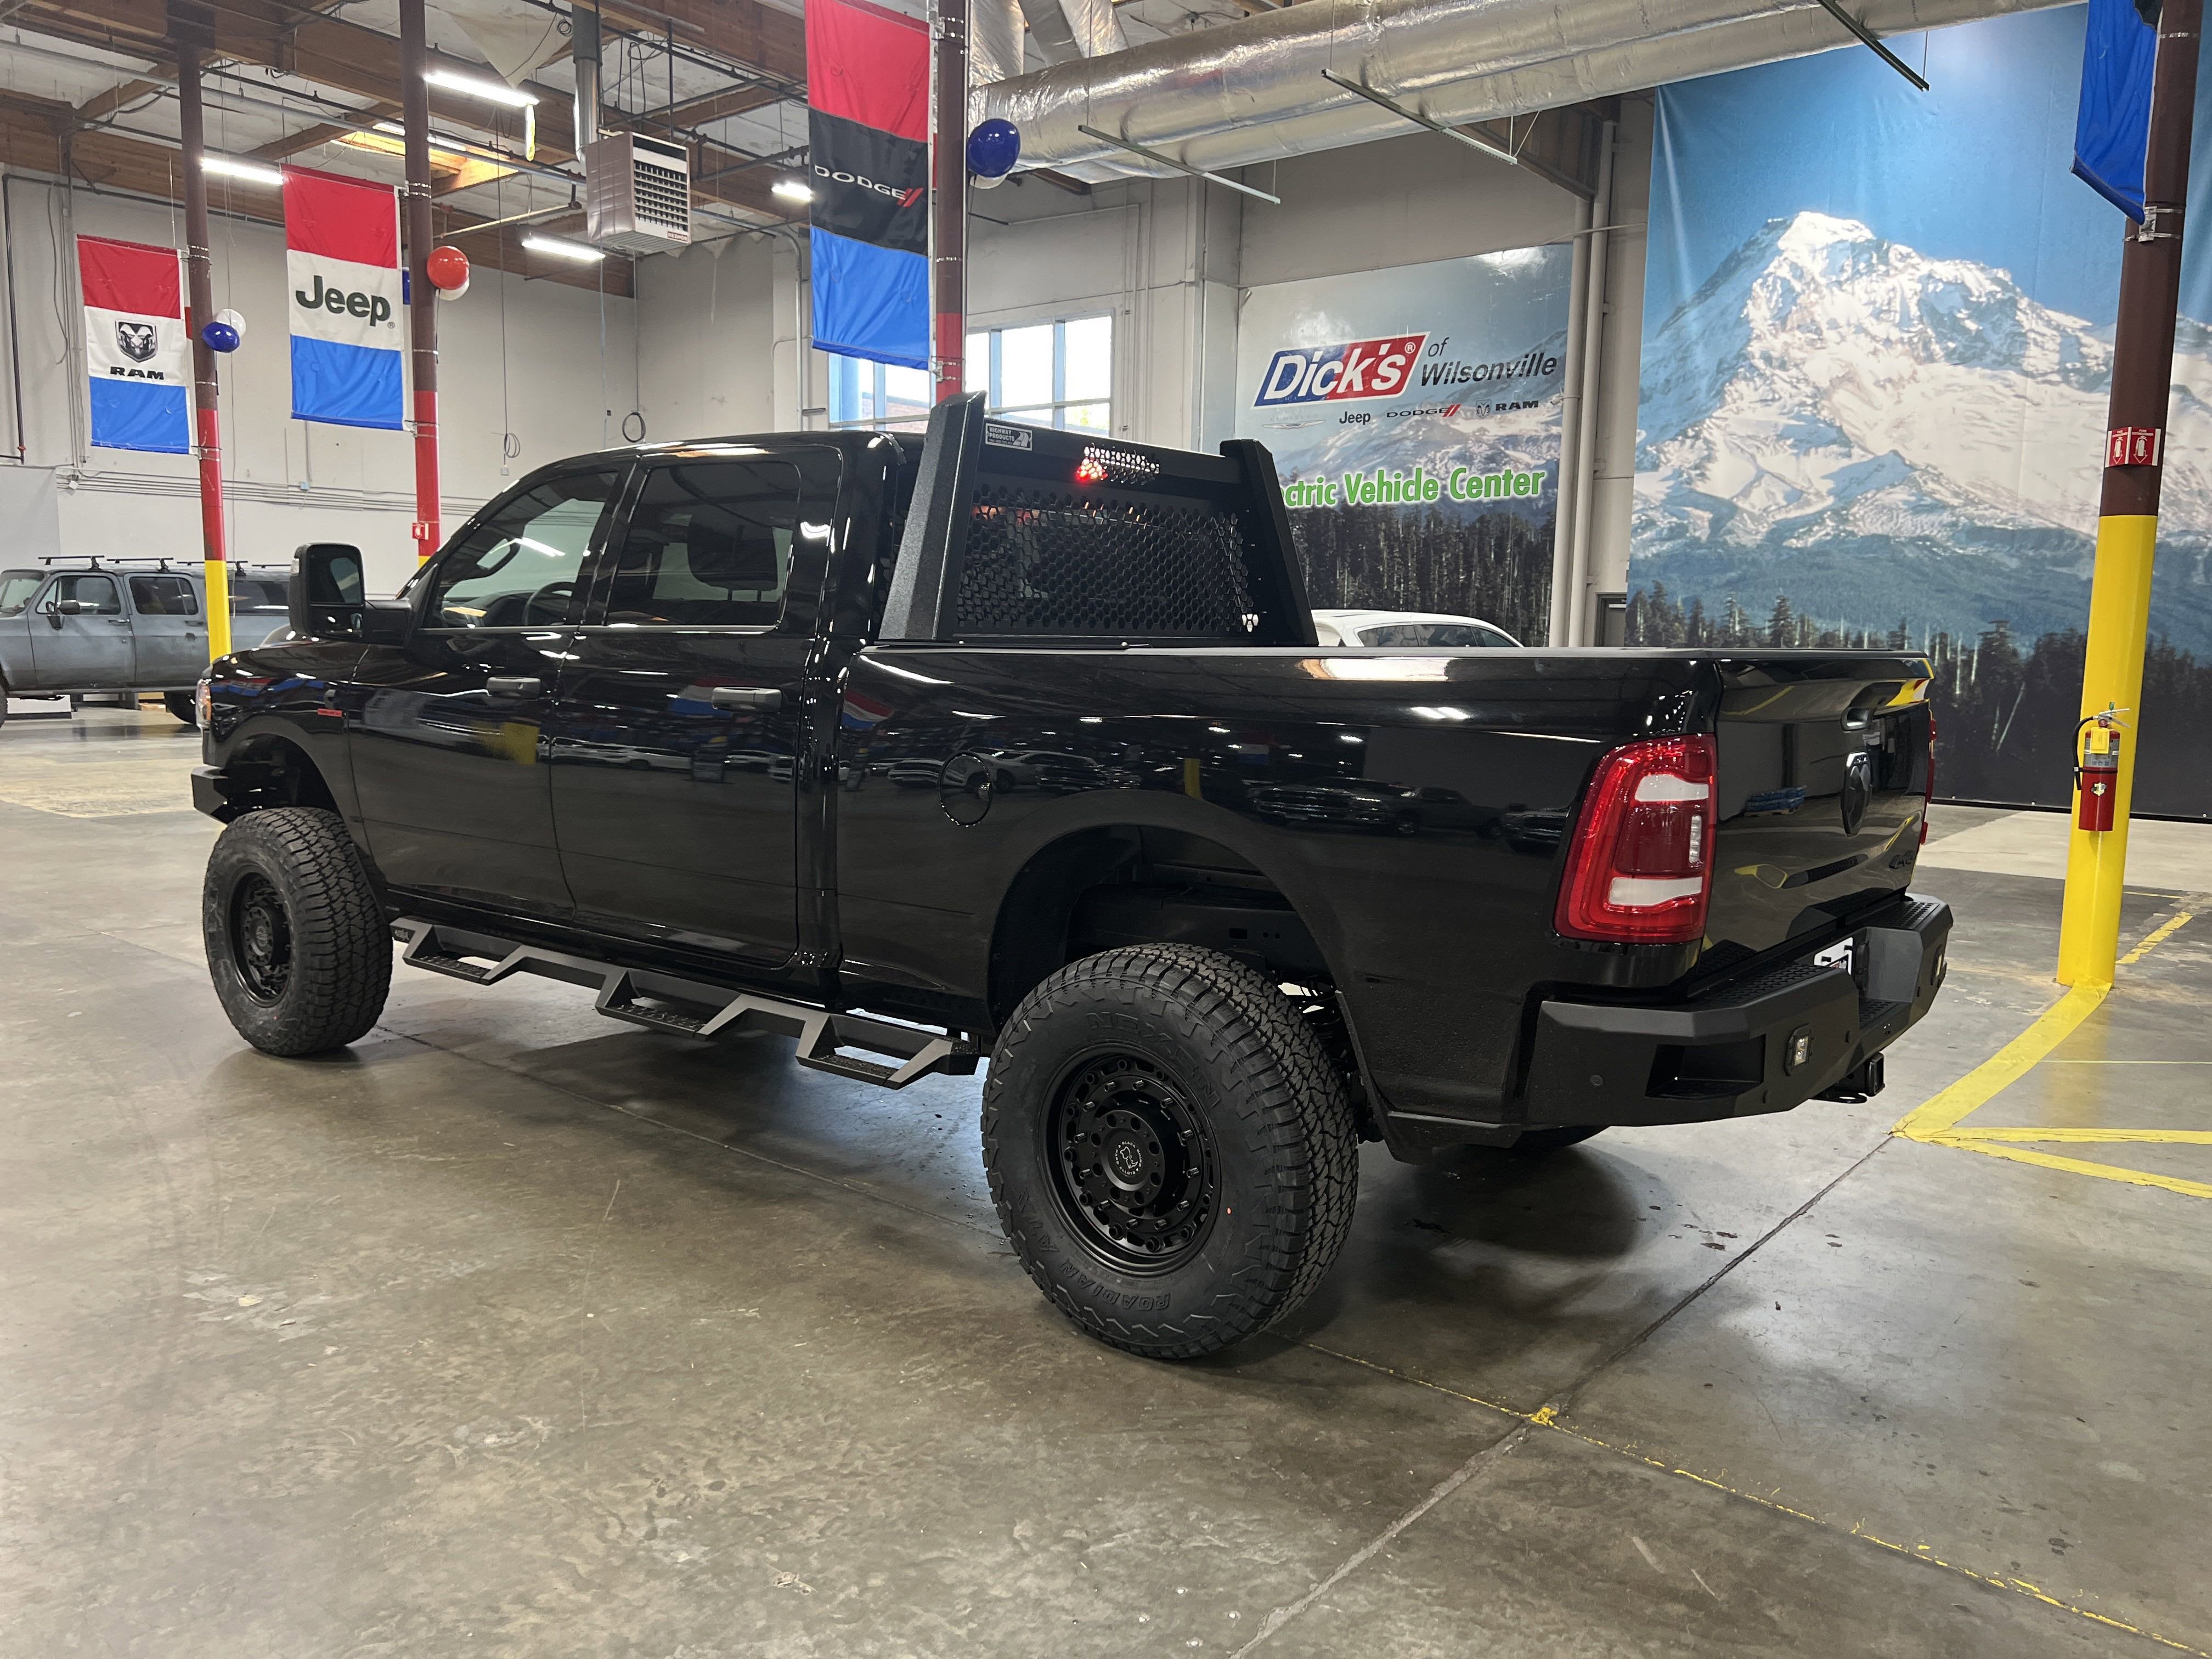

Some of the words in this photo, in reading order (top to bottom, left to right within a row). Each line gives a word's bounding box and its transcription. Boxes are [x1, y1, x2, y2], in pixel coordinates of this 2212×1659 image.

[815, 165, 906, 201] DODGE
[295, 275, 391, 327] Jeep
[1427, 337, 1450, 357] of
[110, 366, 164, 380] RAM
[1421, 352, 1558, 387] Wilsonville
[1339, 411, 1371, 425] Jeep
[1386, 407, 1449, 418] DODGE
[1495, 400, 1539, 411] RAM
[989, 426, 1012, 435] HIGHWAY
[989, 432, 1015, 442] PRODUCTS
[1344, 467, 1439, 504] Vehicle
[1450, 467, 1545, 499] Center
